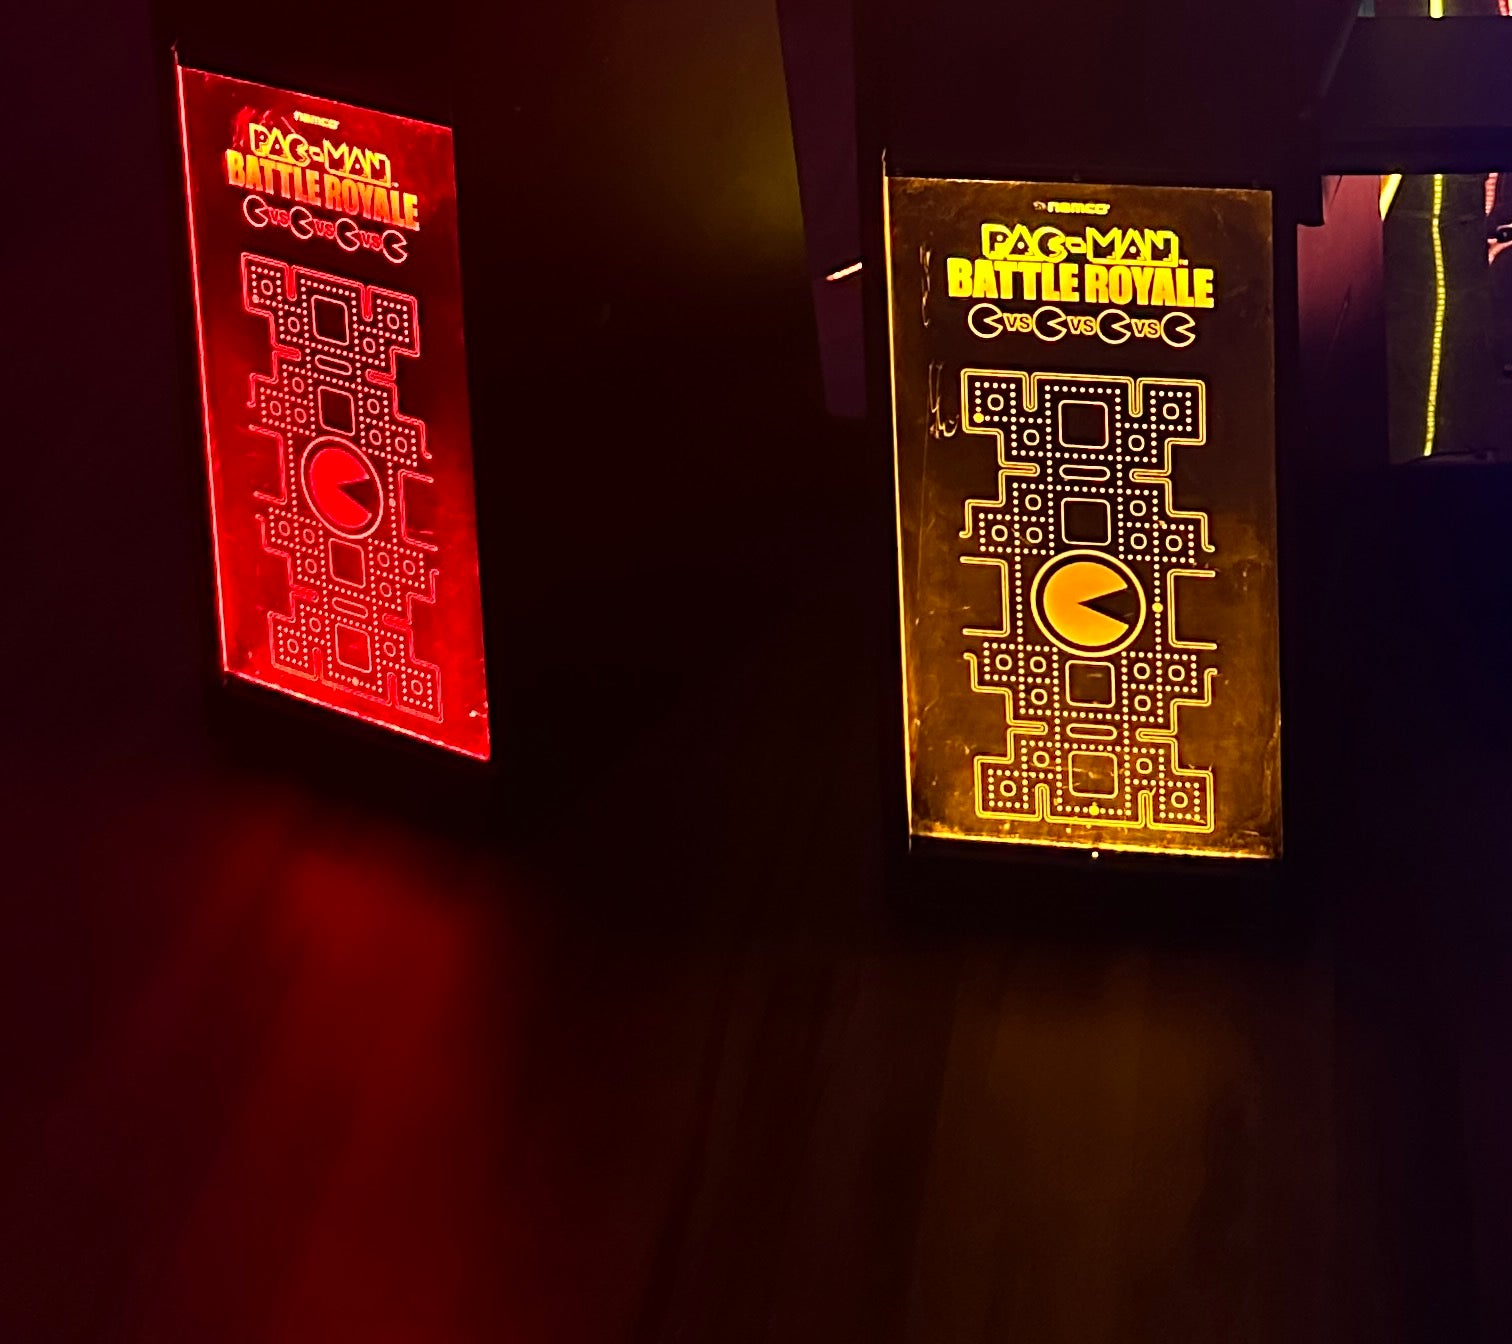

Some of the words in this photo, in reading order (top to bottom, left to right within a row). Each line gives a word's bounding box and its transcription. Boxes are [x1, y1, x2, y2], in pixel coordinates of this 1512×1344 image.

[249, 123, 392, 188] PAC-MAN
[226, 149, 322, 207] BATTLE
[323, 173, 420, 232] ROYALE
[1047, 200, 1111, 215] namco
[269, 206, 290, 227] VS
[314, 218, 335, 240] VS
[361, 230, 382, 251] VS
[981, 222, 1179, 268] PAC-MAN
[946, 257, 1080, 302] BATTLE
[1084, 263, 1215, 309] ROYALE
[1002, 312, 1031, 333] VS
[1067, 316, 1096, 336] VS
[1131, 318, 1160, 339] VS
